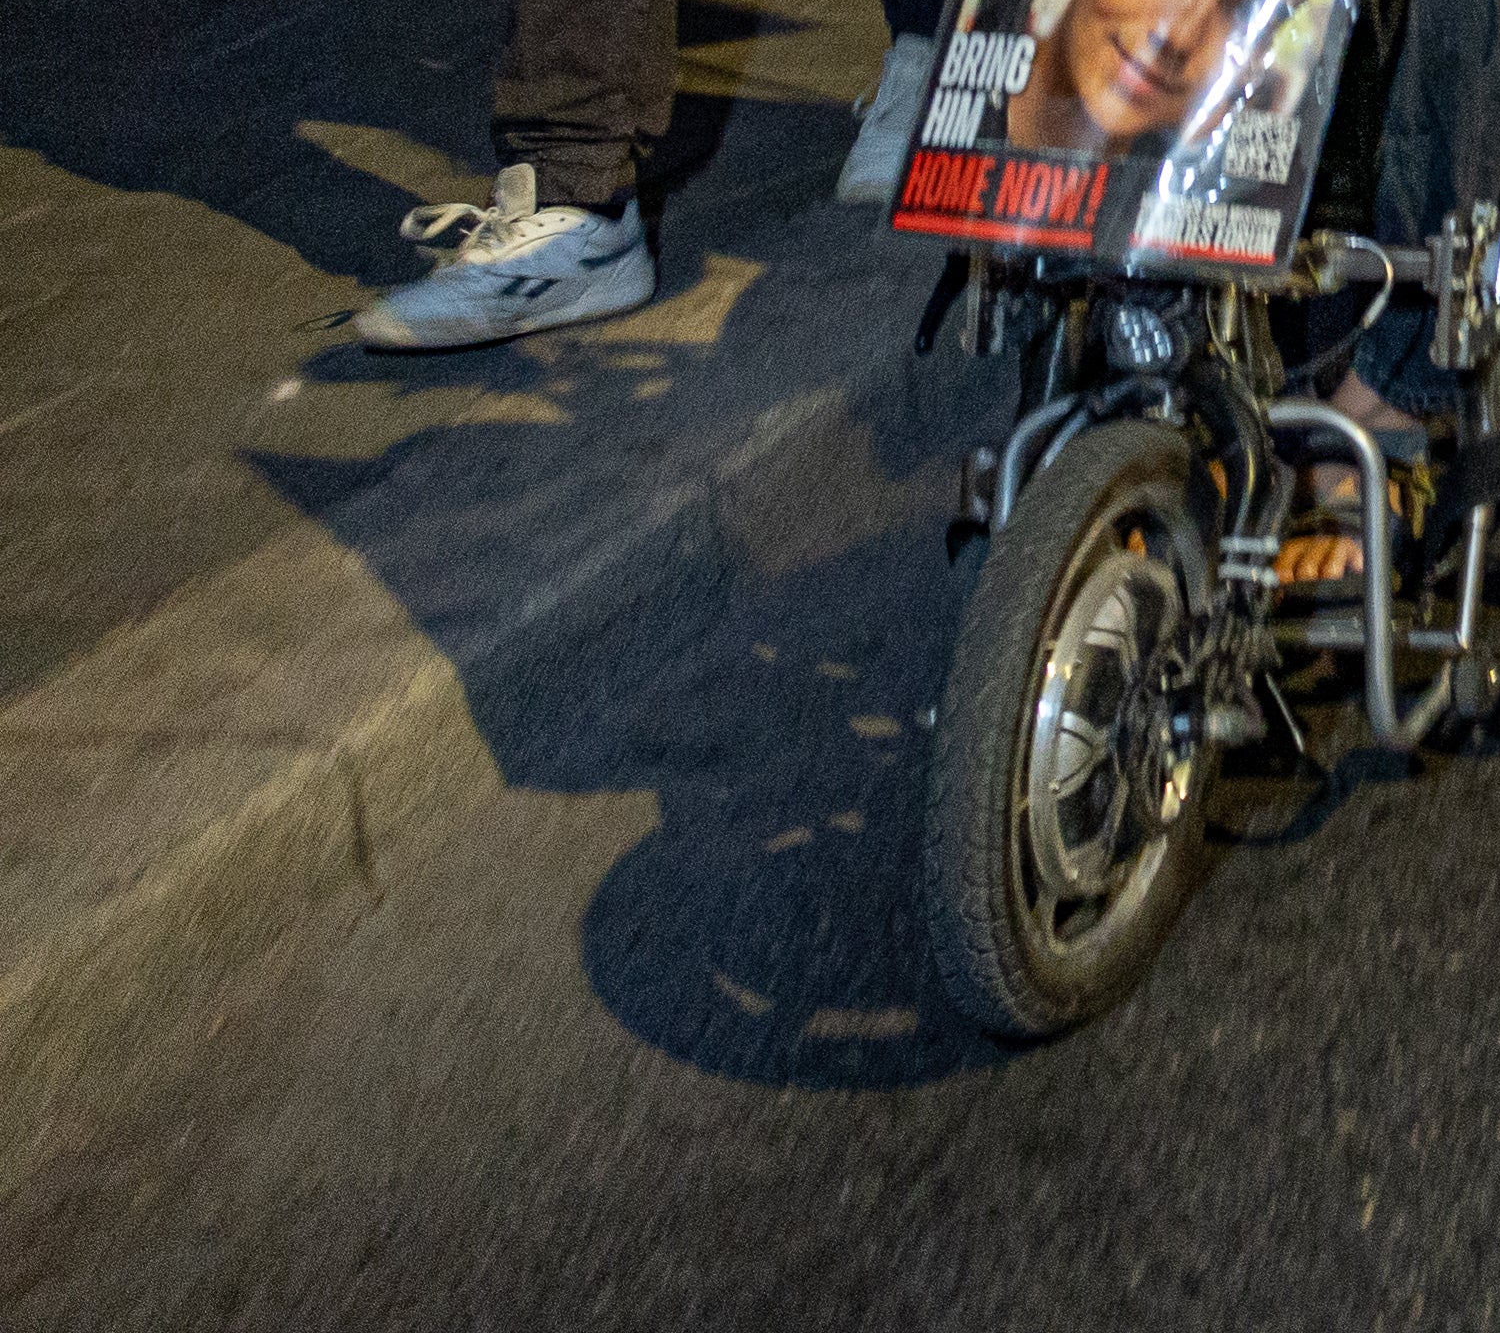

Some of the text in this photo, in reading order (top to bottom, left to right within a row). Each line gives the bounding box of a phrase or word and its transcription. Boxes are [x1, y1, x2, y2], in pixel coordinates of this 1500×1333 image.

[938, 30, 1037, 95] BRING
[921, 87, 986, 149] HIM
[903, 150, 996, 213] HOME
[995, 160, 1110, 227] NOW!
